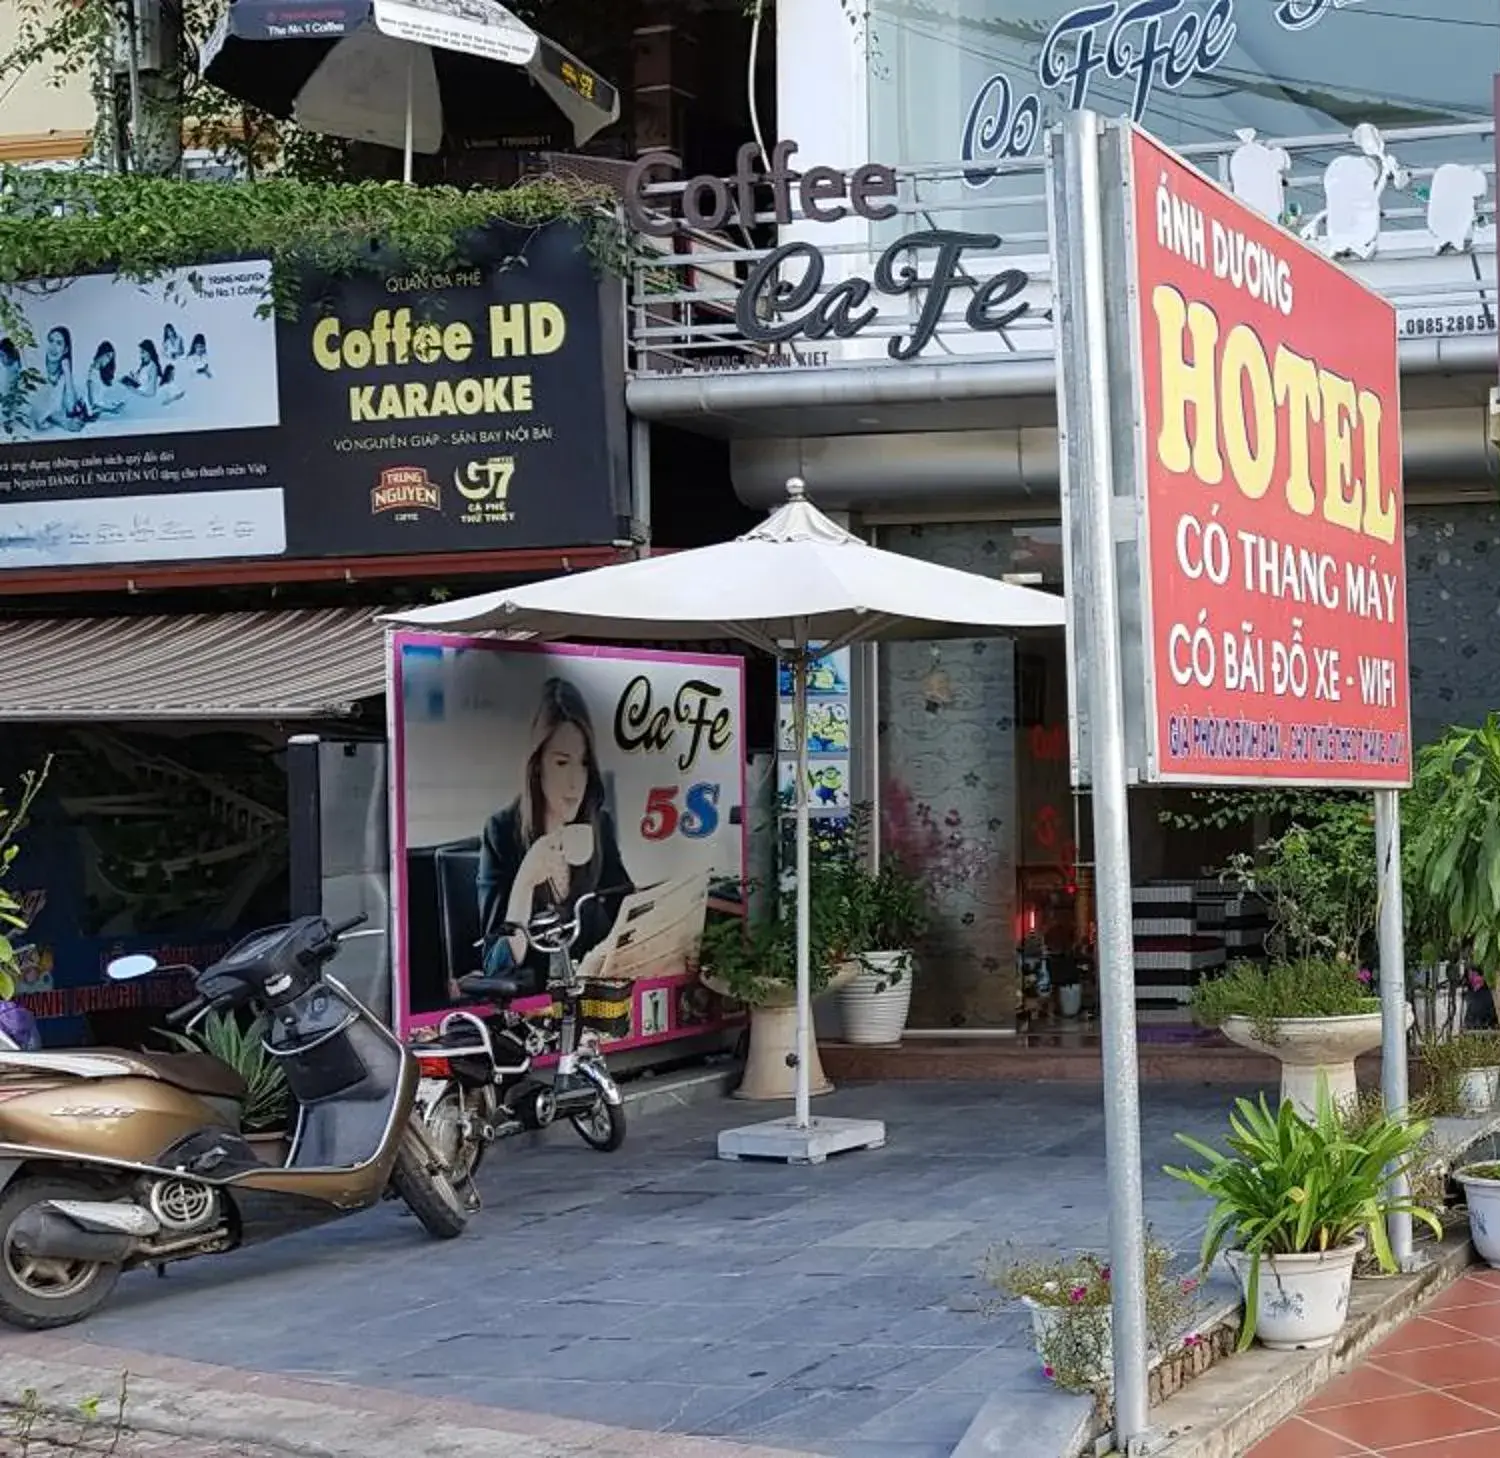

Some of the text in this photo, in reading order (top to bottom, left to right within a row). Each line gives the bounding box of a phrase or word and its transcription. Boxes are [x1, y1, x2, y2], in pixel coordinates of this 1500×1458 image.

[625, 139, 898, 238] Coffee
[1155, 171, 1293, 316] ÁNH DƯƠNG
[312, 301, 566, 371] Coffee HD
[736, 230, 1030, 361] CaFe
[350, 374, 533, 422] KARAOKE
[480, 431, 501, 444] BAY
[1152, 283, 1397, 545] HOTEL
[387, 472, 424, 484] TRUNG
[1176, 503, 1398, 624] CÓ THANG MÁY
[1168, 607, 1216, 688] CÓ
[1223, 619, 1265, 693] BÃI
[1271, 616, 1308, 698] ĐỖ
[1313, 648, 1341, 701] XE
[1358, 655, 1397, 708] WIFI
[614, 675, 733, 771] CaFe
[640, 782, 720, 842] 5S
